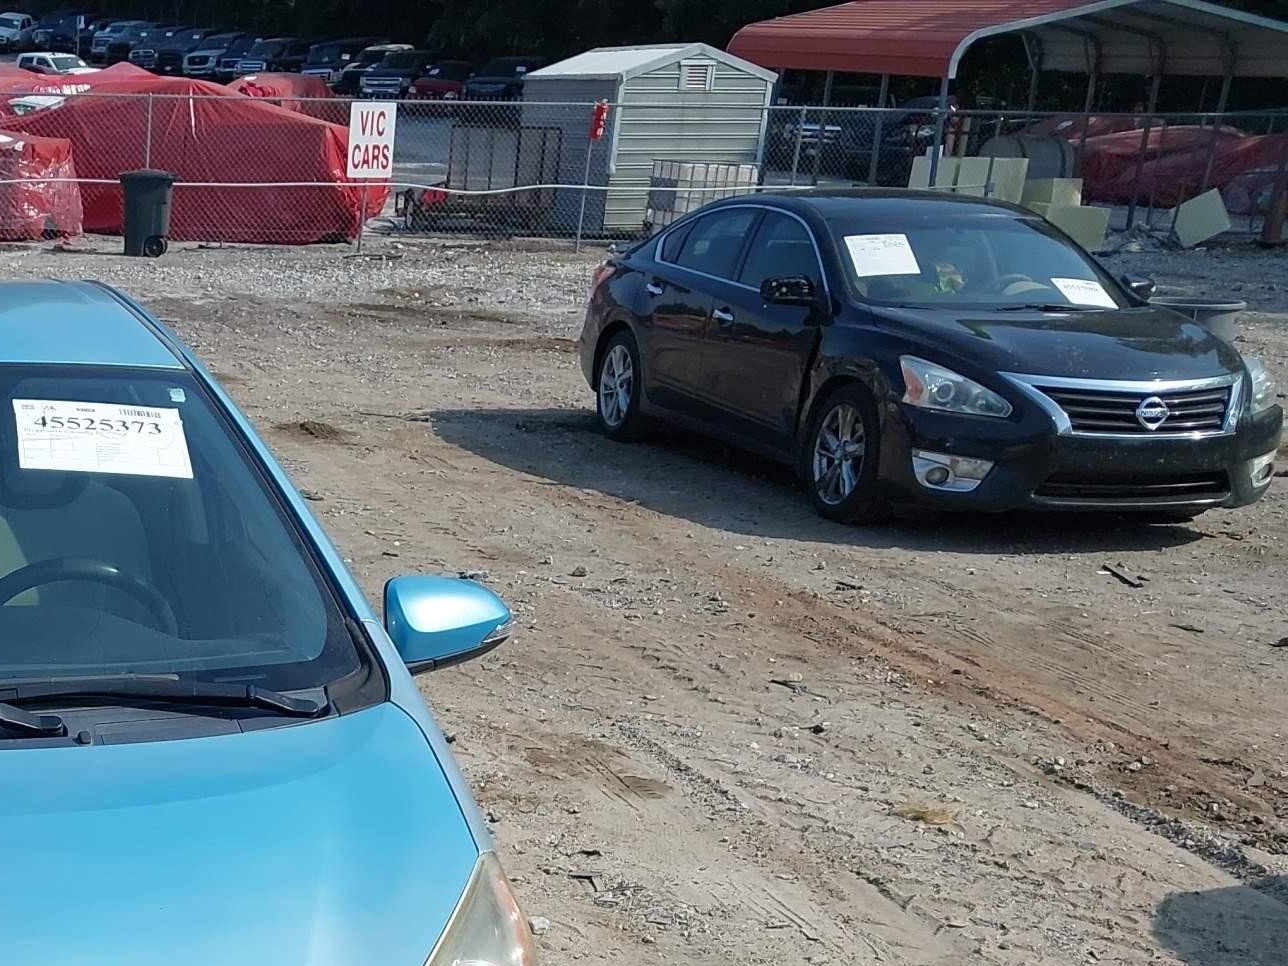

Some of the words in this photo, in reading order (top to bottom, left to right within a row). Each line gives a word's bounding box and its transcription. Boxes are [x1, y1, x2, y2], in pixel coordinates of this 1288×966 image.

[360, 110, 387, 137] VIC
[352, 143, 390, 170] CARS
[33, 415, 162, 434] 45525373
